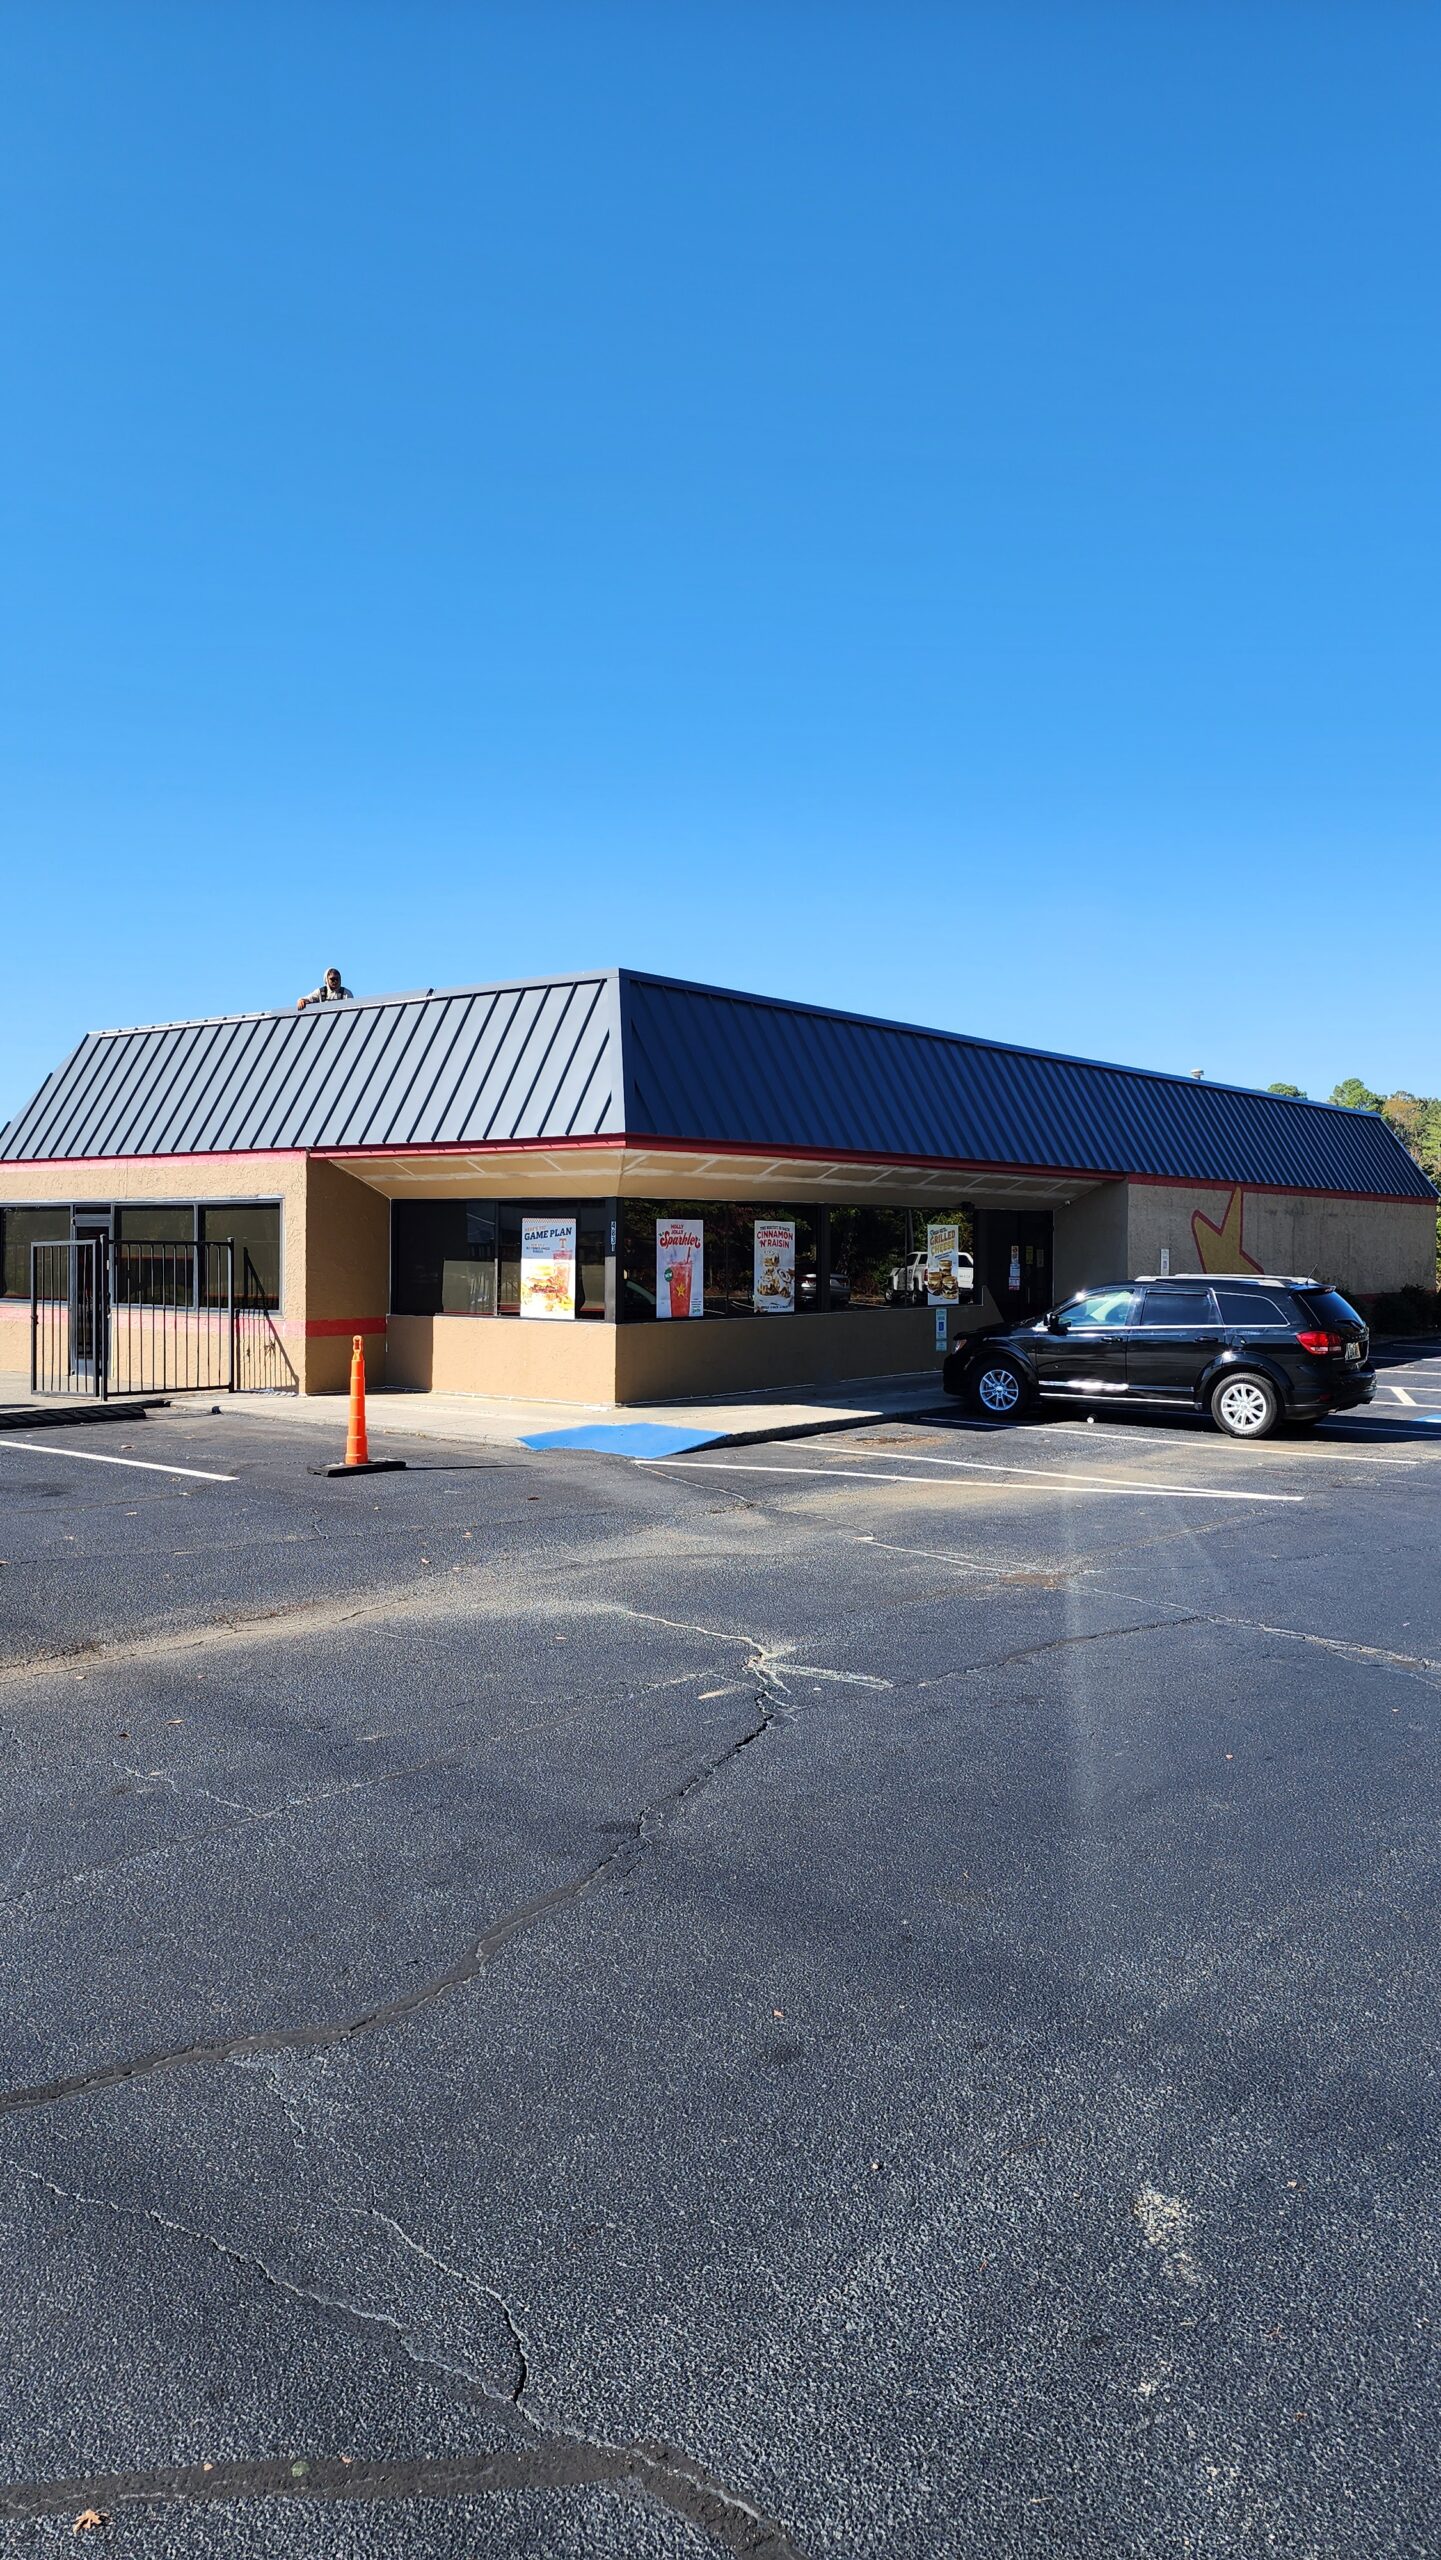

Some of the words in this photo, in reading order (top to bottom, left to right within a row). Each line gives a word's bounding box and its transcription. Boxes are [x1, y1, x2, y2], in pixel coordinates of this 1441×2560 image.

[524, 1230, 549, 1240] GAME
[550, 1227, 572, 1238] PLAN
[756, 1230, 794, 1241] CINNAMON
[930, 1231, 956, 1246] GRILLED
[767, 1239, 790, 1249] RAISIN
[931, 1240, 954, 1256] CHEESE
